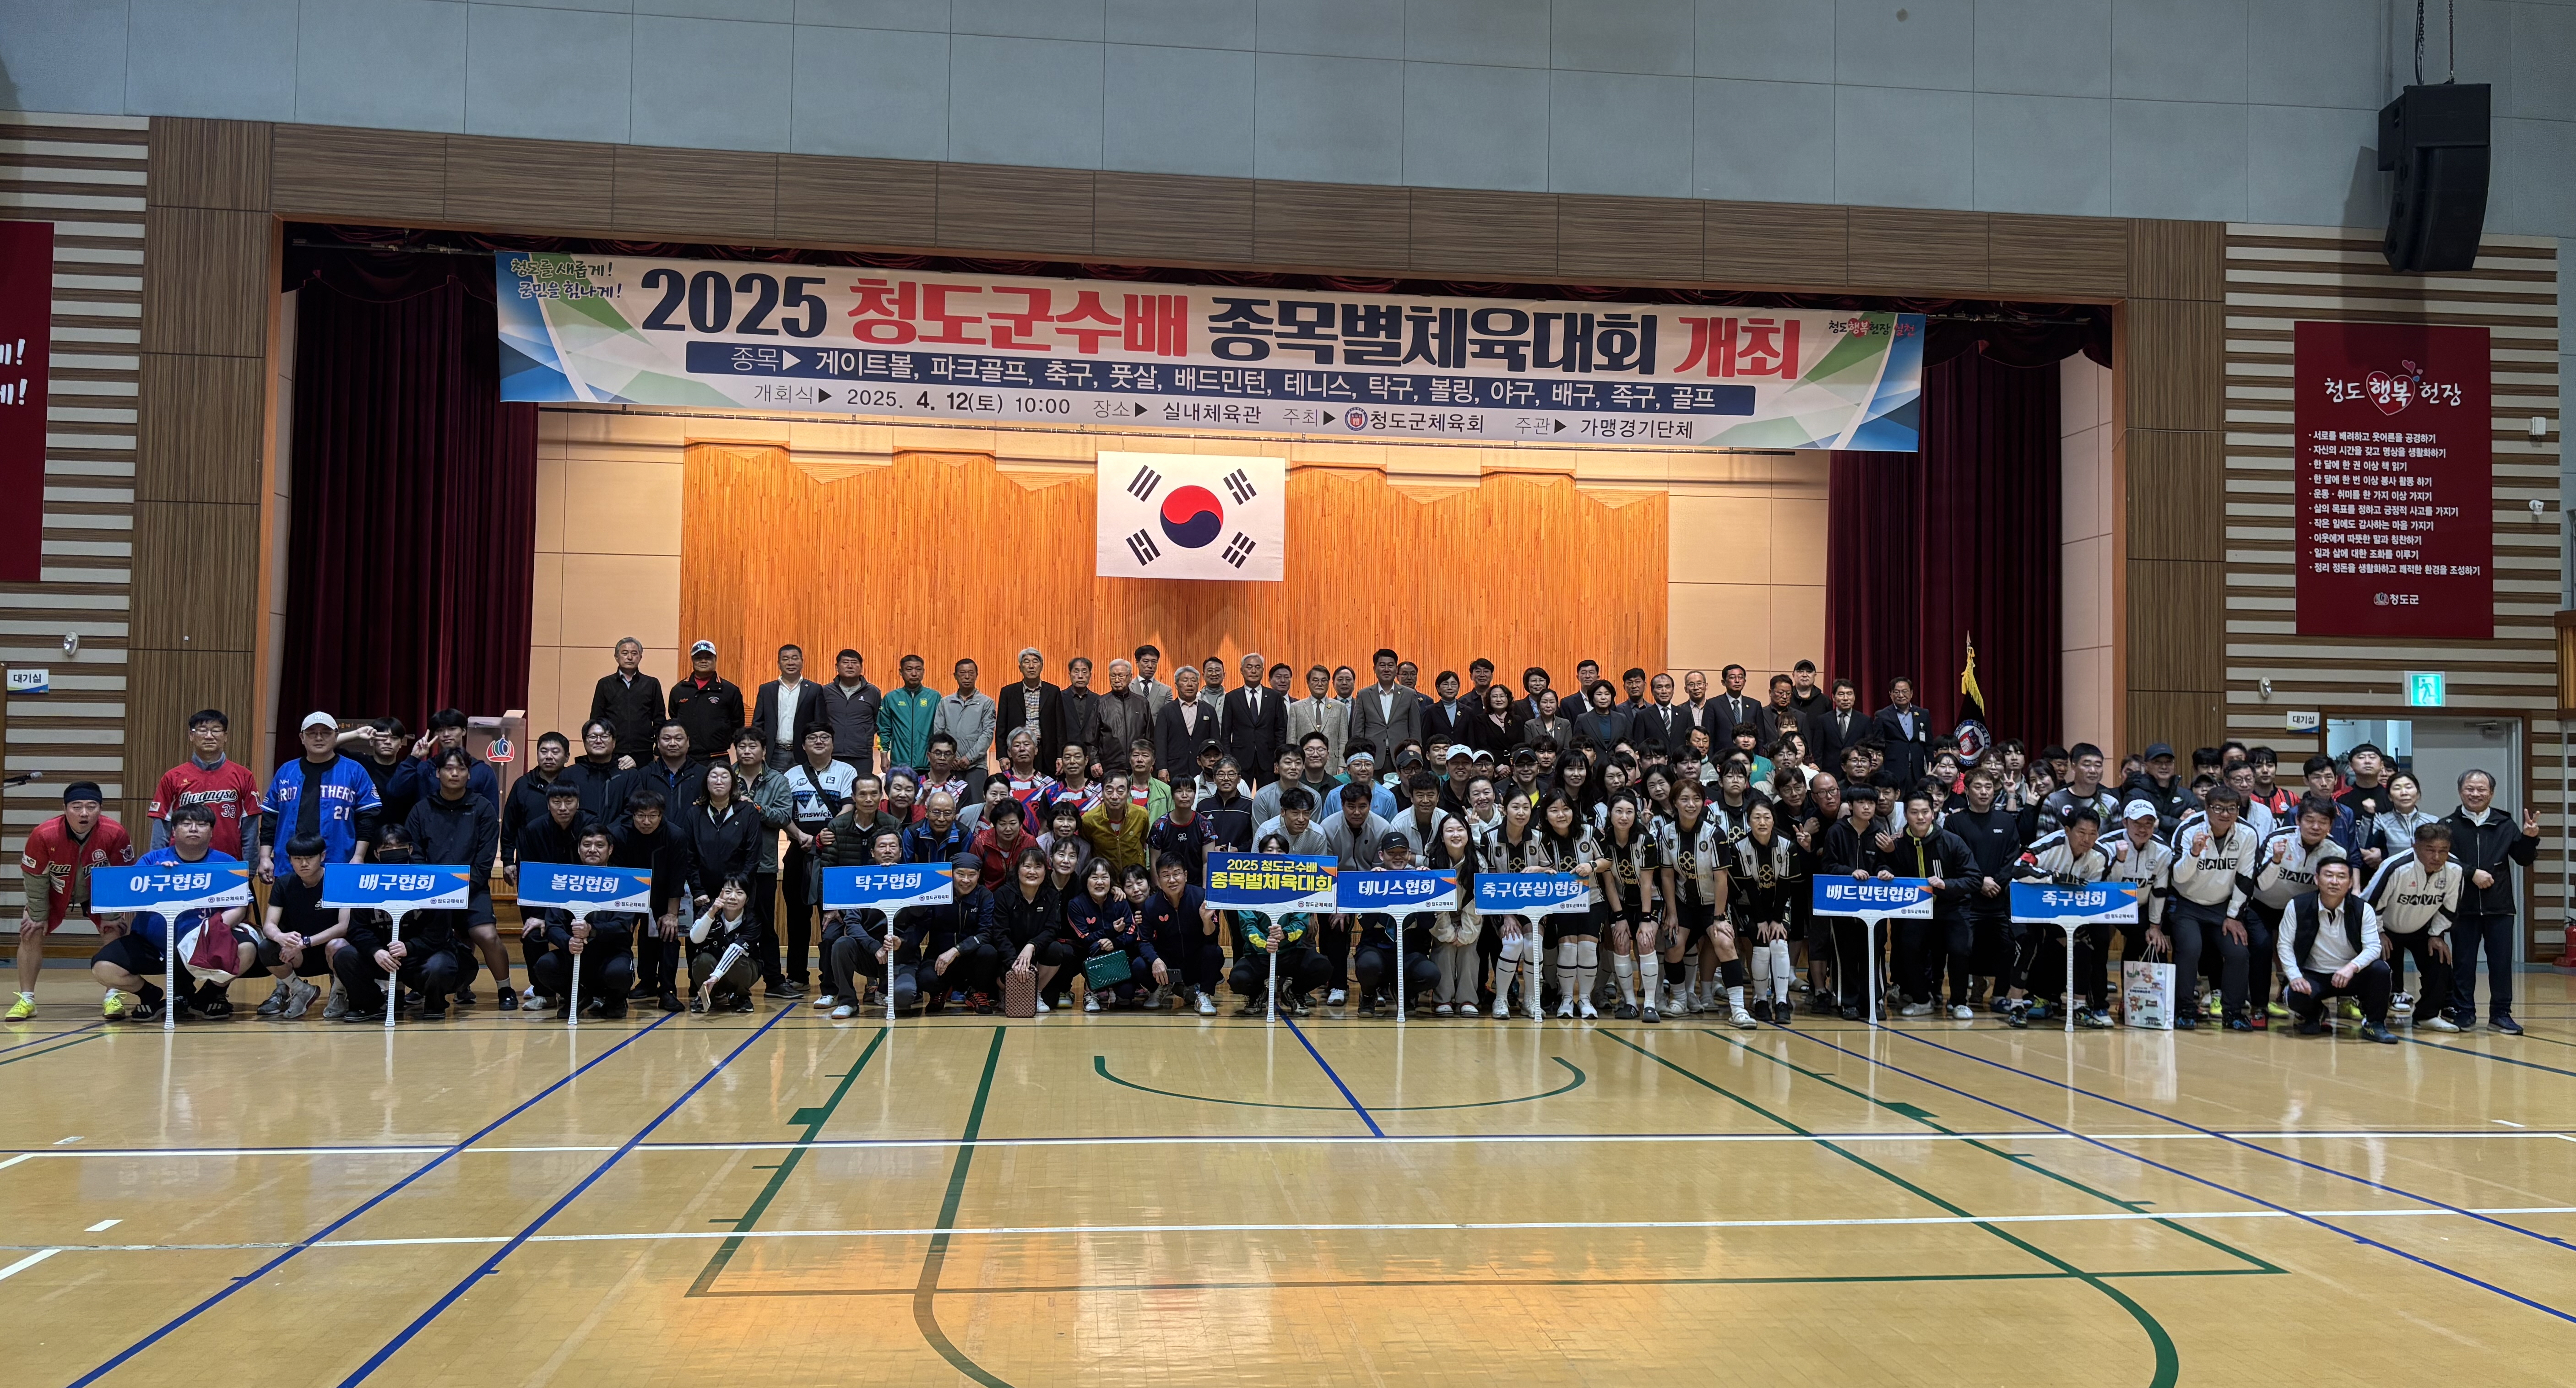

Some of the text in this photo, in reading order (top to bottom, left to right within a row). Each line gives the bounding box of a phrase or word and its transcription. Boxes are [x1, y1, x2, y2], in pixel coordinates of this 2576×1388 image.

[510, 258, 613, 279] 청도를 새롭게!
[518, 280, 622, 299] 군민을 힘나게!
[641, 269, 1800, 380] 2025 청도군수배 종목별체육대회 개최
[732, 348, 1715, 410] 종목 게이트볼, 파크골프, 축구, 풋살, 배드민턴, 테니스, 탁구, 볼링, 야구, 배구, 족구, 골프
[2324, 378, 2462, 407] 청도 행복 헌장
[754, 385, 812, 404] 개회식
[848, 390, 902, 408] 2025.
[917, 391, 934, 410] 4.
[947, 392, 1002, 413] 12(토)
[1016, 397, 1069, 413] 10:00
[1094, 400, 1129, 417] 장소
[1163, 402, 1261, 423] 실내체육관
[1282, 407, 1318, 428] 주최
[1370, 411, 1483, 433] 청도군체육회
[1514, 416, 1551, 436] 주관
[1581, 418, 1692, 439] 가맹경기단체
[2313, 431, 2336, 441] 서로를
[2339, 432, 2370, 441] 배려하고
[2405, 434, 2435, 444] 공경하기
[2314, 445, 2446, 458] 자신의 시간을 갖고 명상을 생활화하기
[2314, 459, 2407, 472] 한 달에 한 권 이상 책 읽기
[2314, 474, 2321, 484] 한
[2324, 475, 2339, 484] 달에
[2343, 475, 2350, 484] 한
[2353, 475, 2360, 485] 번
[2364, 476, 2379, 485] 이상
[2381, 476, 2397, 486] 봉사
[2417, 477, 2431, 487] 하기
[2314, 489, 2432, 501] 운동 취미를 한 가지 이상 가지기
[2332, 504, 2355, 514] 목표를
[2358, 505, 2381, 515] 정하고
[2384, 505, 2407, 515] 긍정적
[2410, 506, 2433, 516] 사고를
[2436, 507, 2458, 517] 가지기
[2314, 519, 2434, 531] 작은 일에도 감사하는 마음 가지기
[2314, 533, 2421, 545] 이웃에게 따뜻한 말과 칭찬하기
[2314, 548, 2419, 560] 일과 삶에 대한 조화를 이루기
[2315, 563, 2329, 572] 정리
[2332, 563, 2355, 573] 정돈을
[2359, 564, 2397, 574] 생활화하고
[2425, 564, 2447, 575] 환경을
[2450, 566, 2480, 575] 조성하기
[2390, 594, 2419, 605] 청도군
[13, 673, 41, 683] 대기실
[2293, 716, 2315, 724] 대기실
[320, 785, 356, 803] THERS
[221, 804, 236, 819] 33
[333, 806, 350, 821] 21
[1227, 860, 1318, 873] 2025 청도군수배
[130, 873, 212, 893] 야구협회
[359, 874, 435, 891] 배구협회
[552, 874, 619, 893] 볼링협회
[856, 873, 921, 891] 탁구협회
[1211, 872, 1332, 892] 종목별체육대회
[1359, 879, 1435, 896] 테니스협회
[1481, 881, 1583, 898] 축구(풋살)협회
[1826, 885, 1919, 902] 배드민턴협회
[2042, 891, 2106, 906] 족구협회
